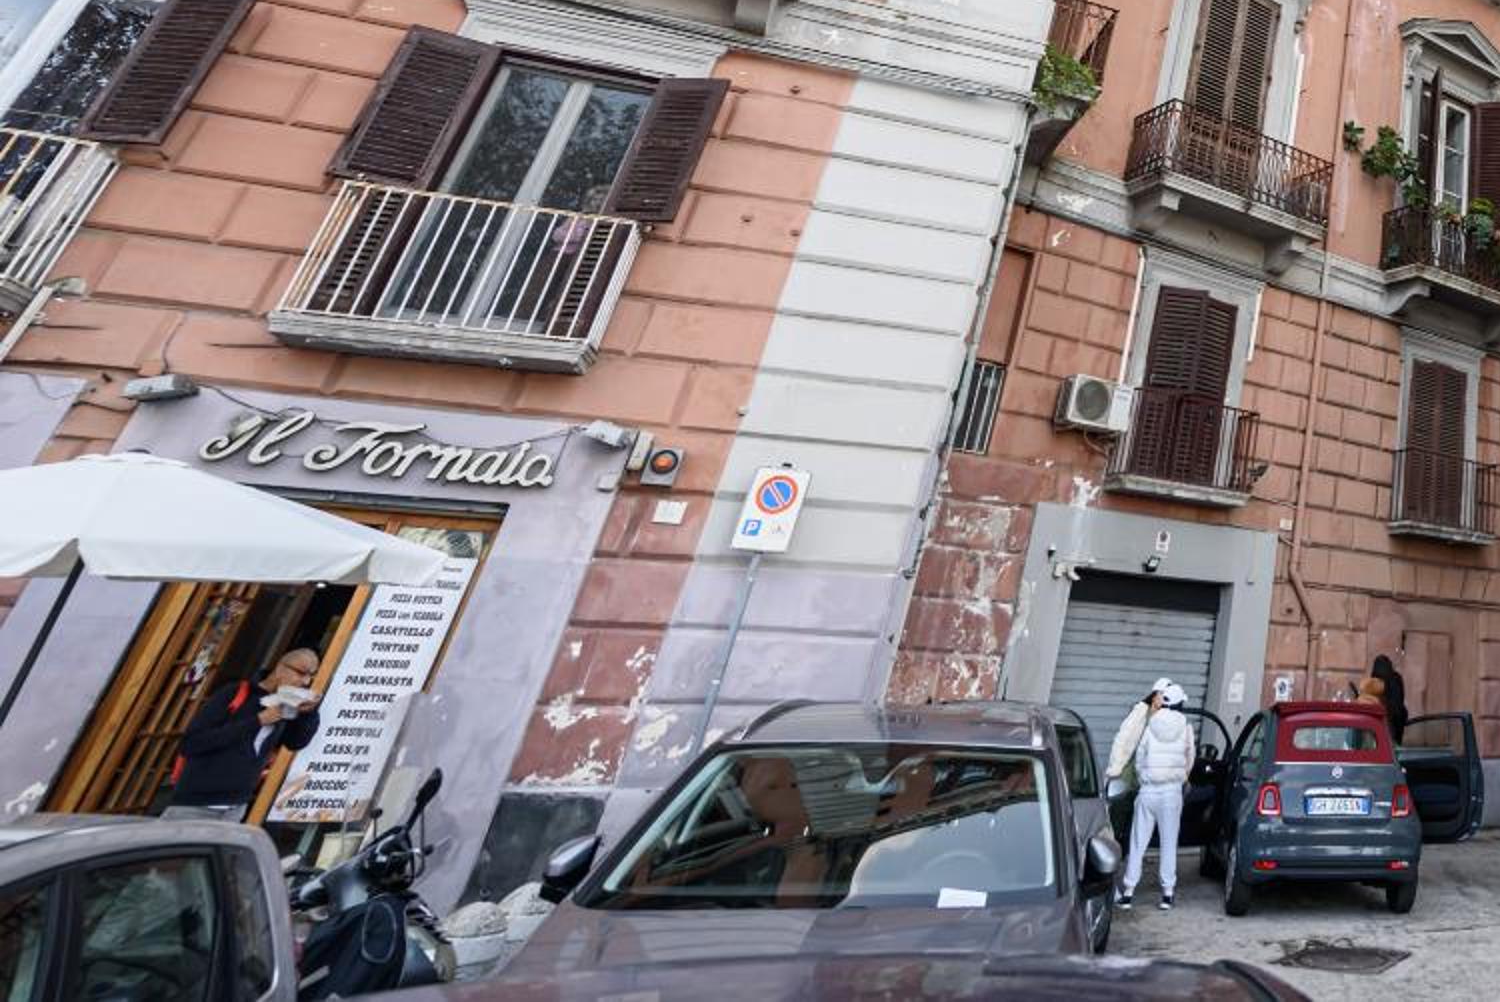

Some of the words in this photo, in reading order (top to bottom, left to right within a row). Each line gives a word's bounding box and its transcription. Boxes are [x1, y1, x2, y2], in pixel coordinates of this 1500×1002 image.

[199, 410, 316, 465] Il
[303, 421, 554, 487] Fornaio
[370, 625, 434, 637] CASATIELLO
[371, 642, 420, 653] TORTANO
